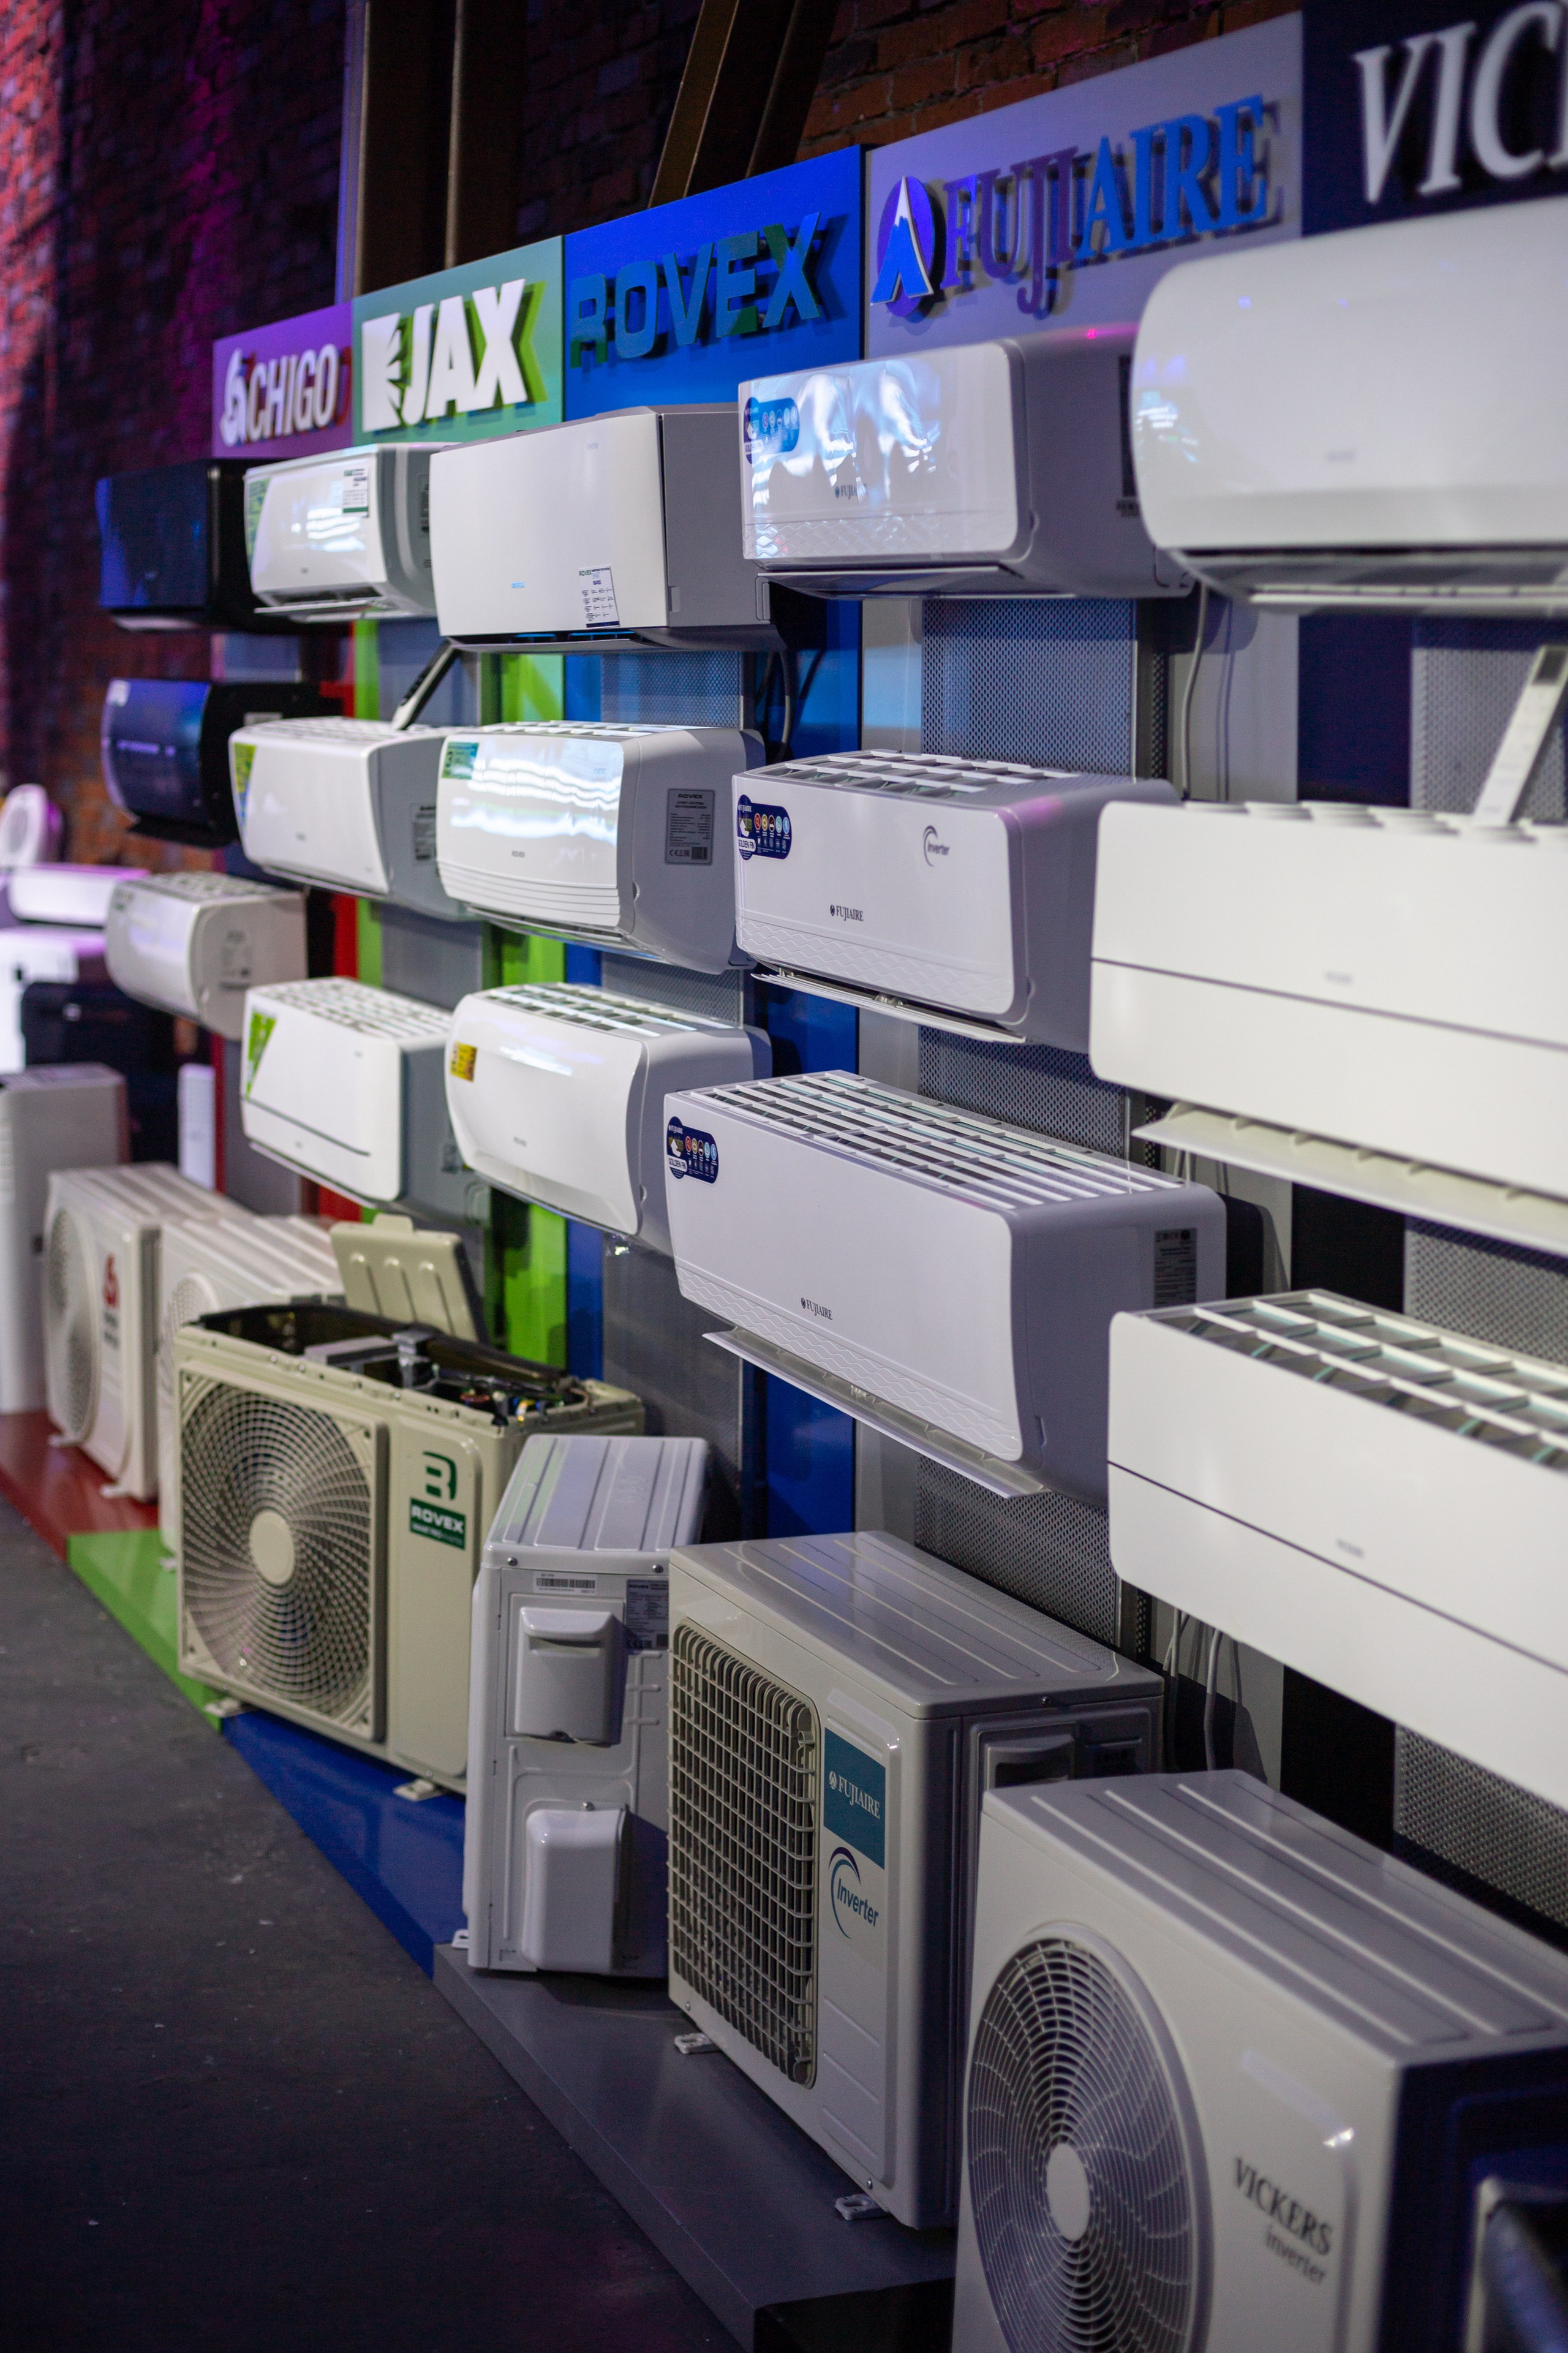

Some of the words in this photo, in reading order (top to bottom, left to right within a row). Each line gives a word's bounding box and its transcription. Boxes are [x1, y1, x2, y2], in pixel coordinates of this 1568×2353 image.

[1352, 1, 1568, 205] VIC
[940, 94, 1268, 314] FUJIAIRE
[570, 211, 821, 369] ROVEX
[401, 279, 528, 425] JAX
[247, 343, 337, 442] CHIGO
[836, 905, 864, 921] FUJIAIRE
[669, 1158, 681, 1168] GOLDEN
[806, 1299, 833, 1320] FUJIAIRE
[412, 1505, 464, 1534] ROVEX
[839, 1775, 880, 1819] FUJIAIRE
[837, 1878, 879, 1927] Inverter
[1235, 2155, 1334, 2256] VICKERS
[1265, 2223, 1327, 2284] inverter
